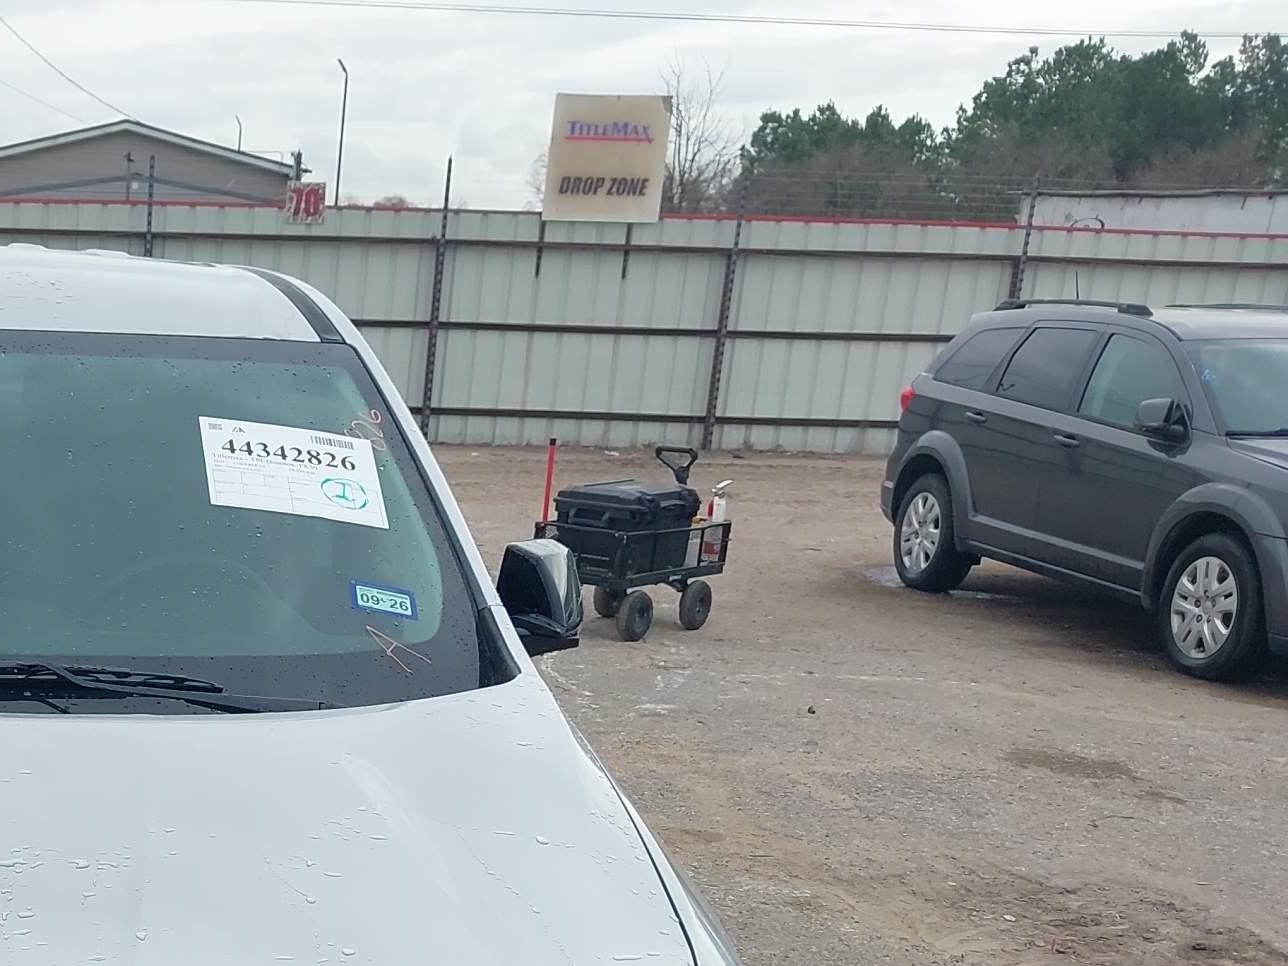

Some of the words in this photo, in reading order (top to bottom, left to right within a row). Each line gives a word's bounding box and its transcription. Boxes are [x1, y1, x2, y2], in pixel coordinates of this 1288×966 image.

[558, 176, 605, 196] DROP
[606, 177, 650, 197] ZONE
[221, 439, 357, 471] 44342826
[360, 593, 380, 606] 09
[389, 598, 409, 612] 26
